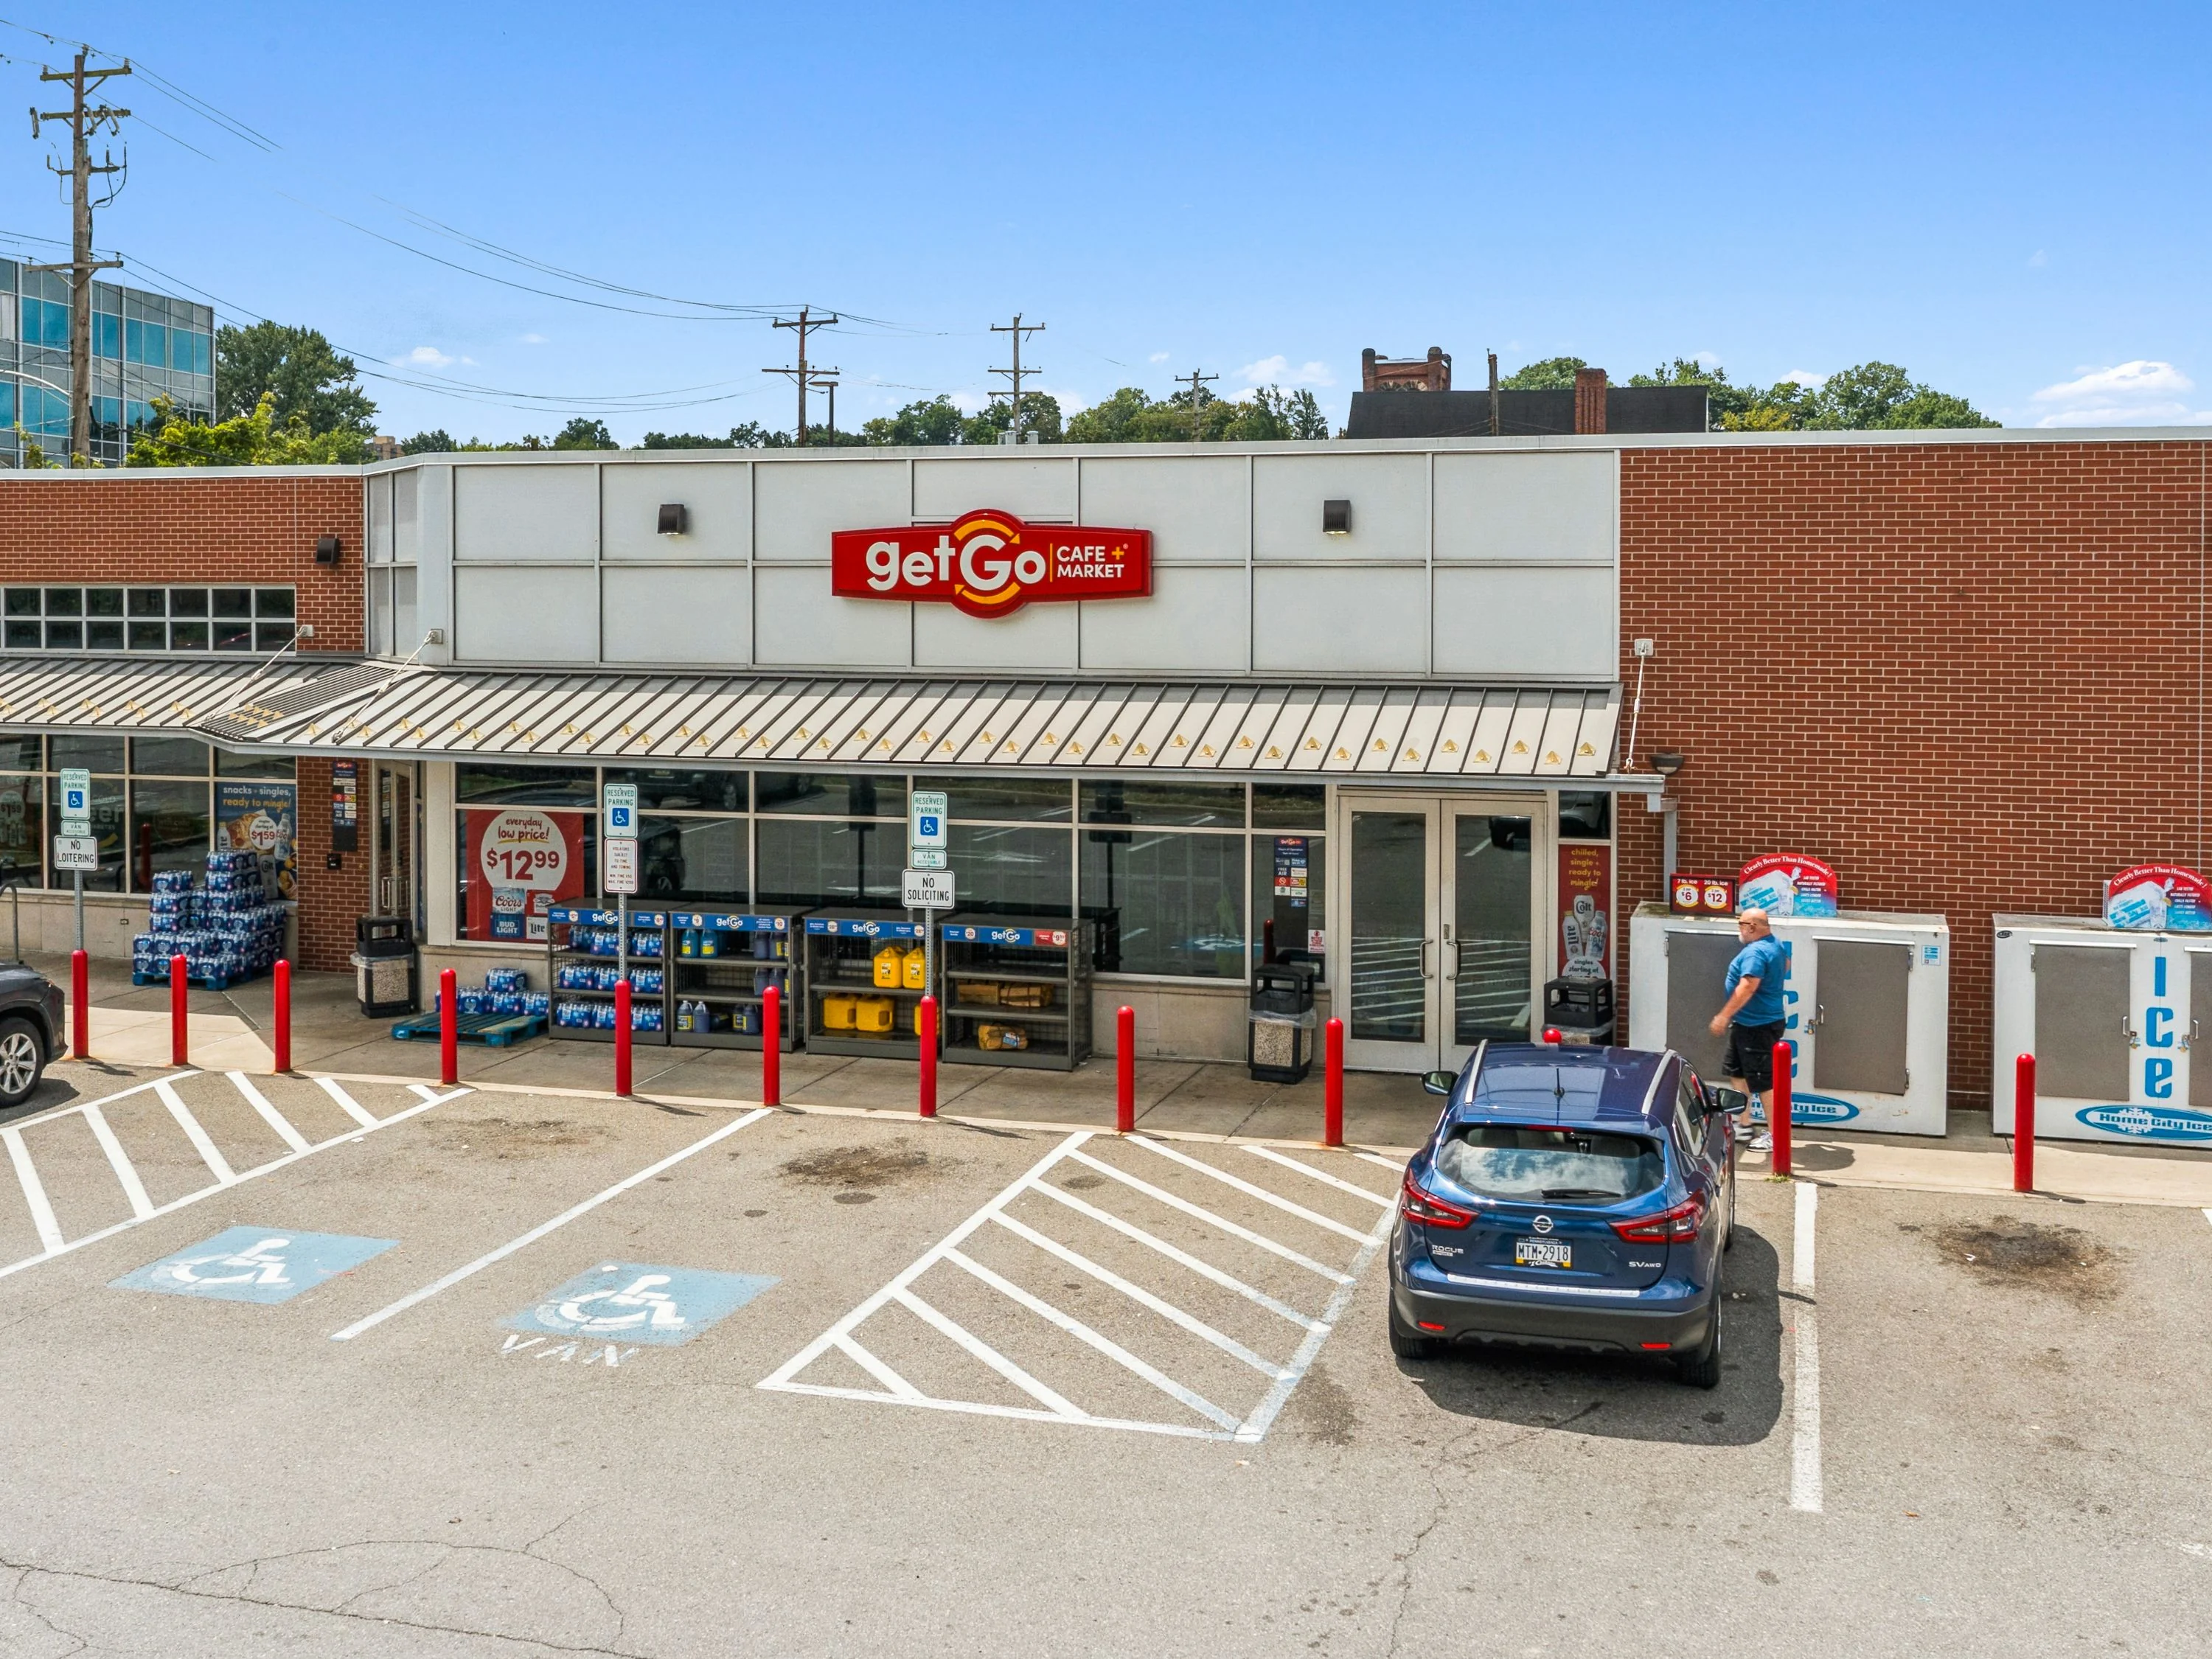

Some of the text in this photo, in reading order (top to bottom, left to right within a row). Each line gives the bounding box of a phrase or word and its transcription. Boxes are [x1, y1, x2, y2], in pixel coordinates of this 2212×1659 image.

[1057, 546, 1105, 562] CAFE
[866, 535, 1046, 591] getGo
[1057, 564, 1124, 578] MARKET
[223, 785, 252, 794] snacks
[260, 786, 291, 797] singles,
[223, 797, 249, 809] ready
[252, 799, 261, 807] to
[915, 797, 944, 805] RESERVED
[506, 816, 542, 830] everyday
[498, 826, 549, 843] low price!
[71, 841, 80, 849] NO
[58, 853, 94, 863] LOITERING
[1571, 849, 1599, 857] chilled,
[1571, 858, 1593, 867] single
[1744, 861, 1762, 874] Clearly
[1568, 869, 1591, 877] ready
[2114, 872, 2134, 886] Clearly
[2134, 868, 2153, 876] Better
[922, 877, 934, 888] NO
[908, 889, 949, 901] SOLICITING
[1682, 892, 1691, 900] $6
[1708, 893, 1722, 902] $12
[495, 895, 521, 907] Coors
[1576, 900, 1592, 914] Colt
[592, 913, 618, 922] getGo
[716, 917, 743, 927] getGo
[531, 924, 545, 933] Lite
[852, 923, 880, 933] getGo
[992, 930, 1020, 940] getGo
[1568, 925, 1579, 945] Lite
[2145, 956, 2173, 1098] Ice
[1812, 1105, 1837, 1113] Ice
[2100, 1113, 2212, 1130] Home City Ice
[1432, 1245, 1464, 1253] ROGUE
[501, 1334, 640, 1367] VAN
